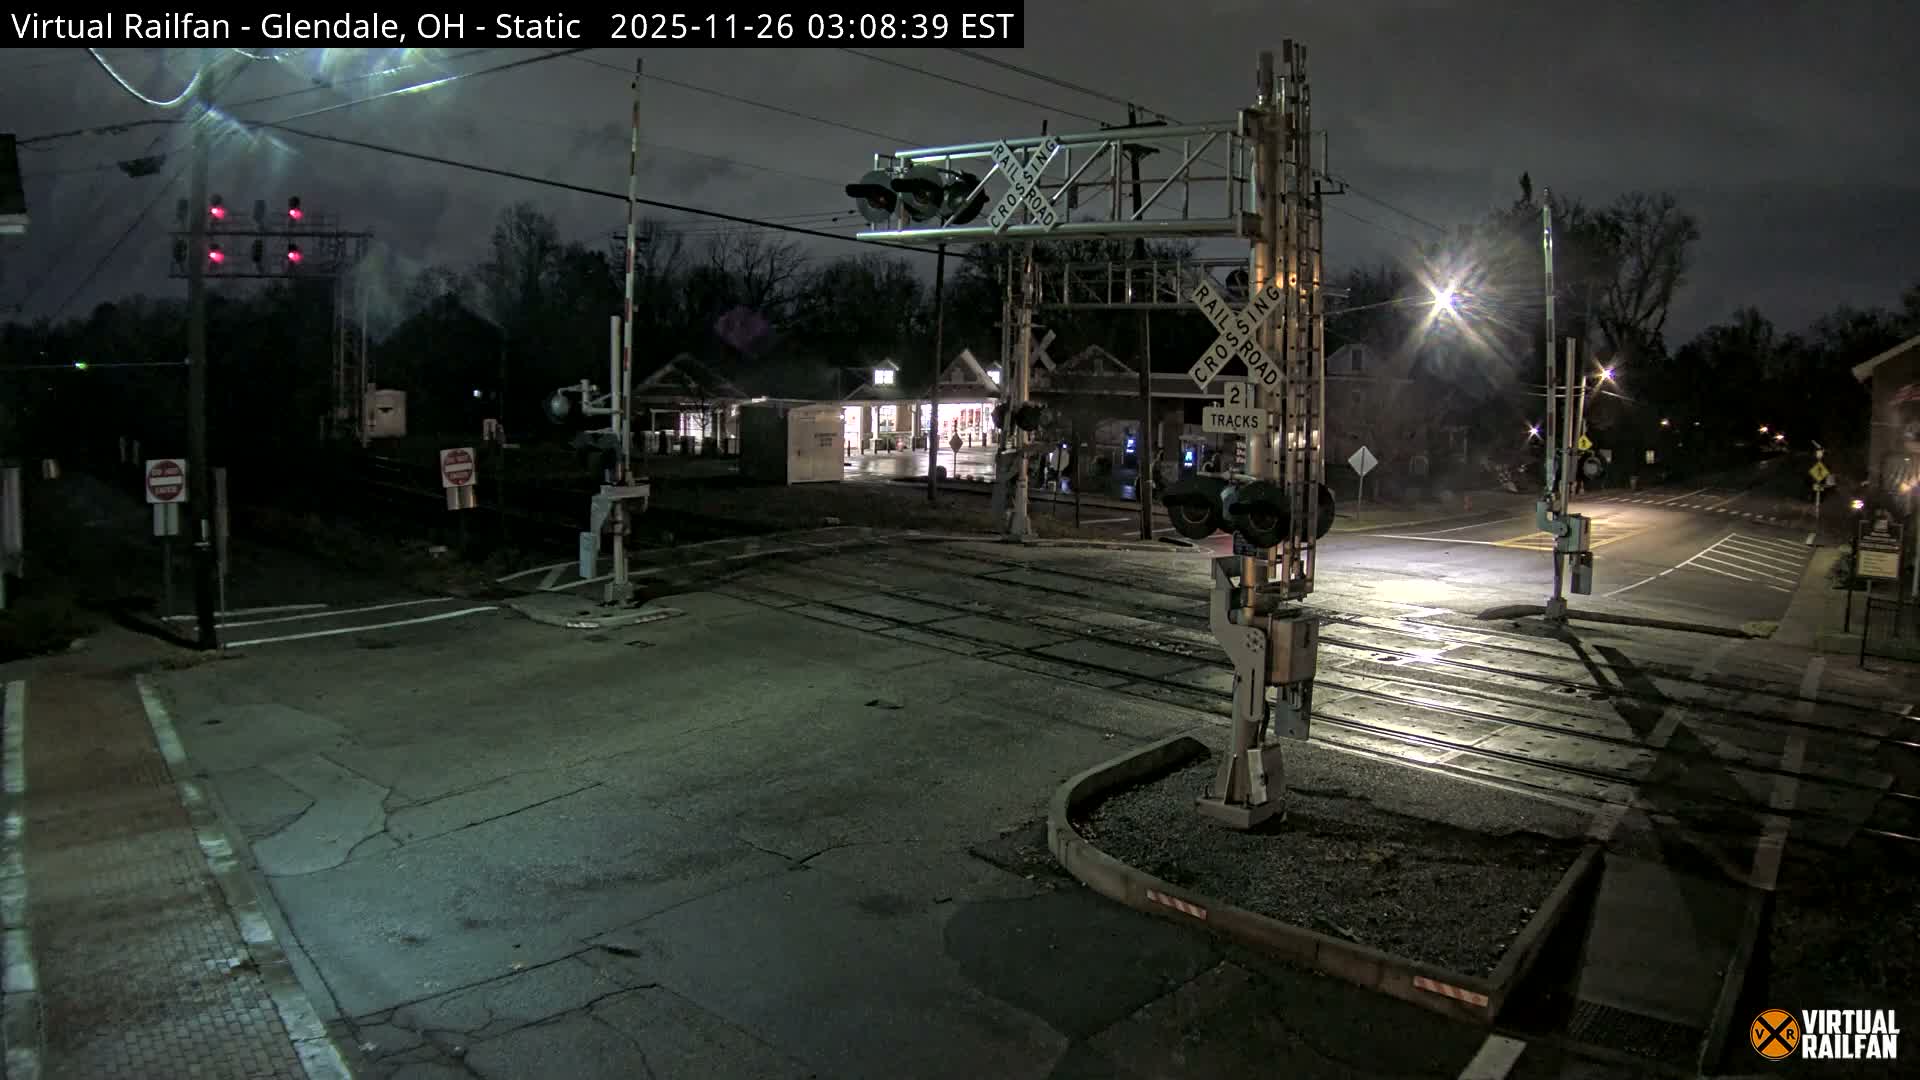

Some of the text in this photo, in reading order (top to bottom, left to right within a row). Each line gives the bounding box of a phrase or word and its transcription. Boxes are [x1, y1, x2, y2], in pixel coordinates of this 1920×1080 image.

[991, 139, 1057, 228] CROSSING
[1194, 285, 1280, 383] CROSSING
[1211, 414, 1259, 429] TRACKS
[1229, 387, 1240, 404] 2
